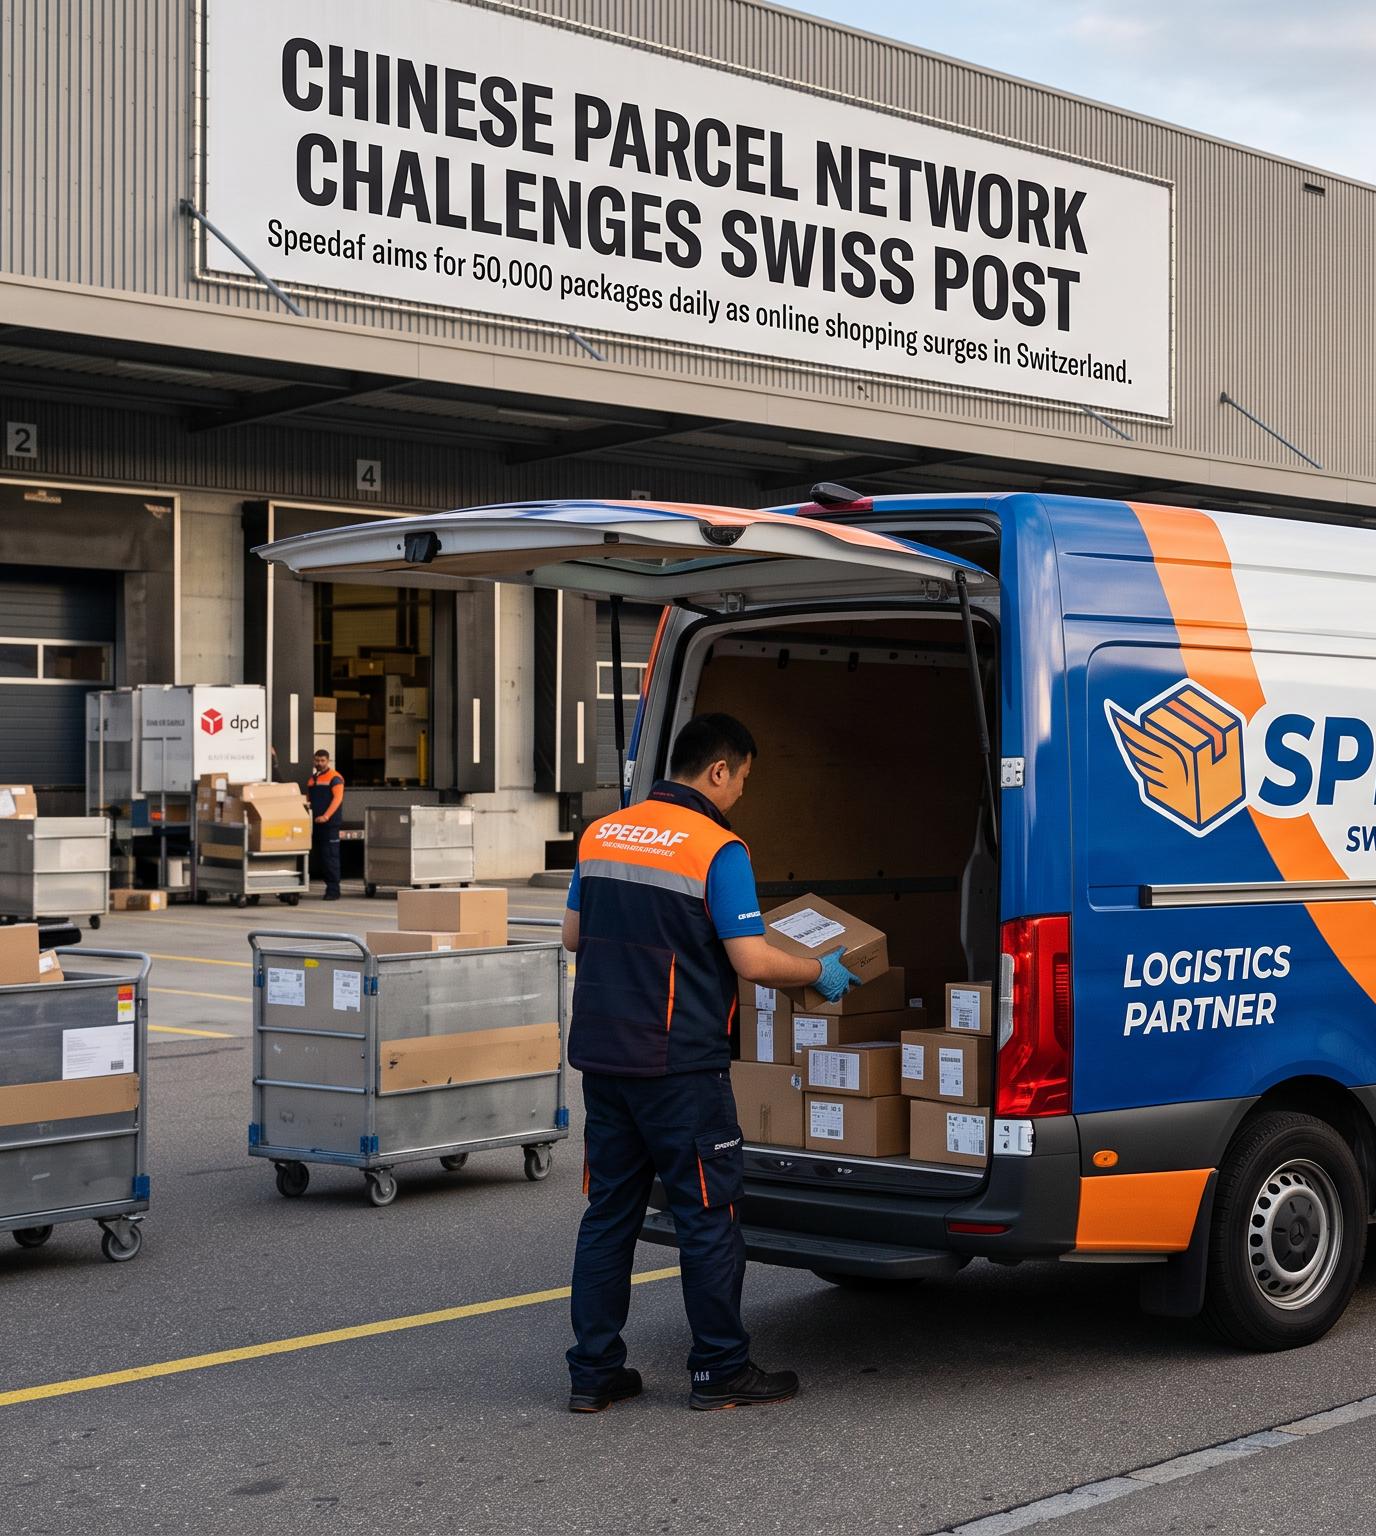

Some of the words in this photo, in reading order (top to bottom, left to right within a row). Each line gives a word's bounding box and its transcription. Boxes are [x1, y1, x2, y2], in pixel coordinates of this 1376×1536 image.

[281, 37, 554, 156] CHINESE
[574, 92, 799, 202] PARCEL
[816, 140, 1089, 255] NETWORK
[296, 132, 702, 269] CHALLENGES
[720, 209, 915, 305] SWISS
[934, 245, 1081, 332] POST
[267, 218, 366, 261] Speedaf
[372, 238, 428, 271] aims
[433, 246, 467, 277] for
[472, 253, 553, 292] 50,000
[560, 272, 663, 312] packages
[669, 286, 721, 324] daily
[726, 302, 750, 323] as
[756, 303, 819, 335] online
[825, 312, 918, 357] shopping
[923, 334, 988, 364] surges
[994, 338, 1011, 365] in
[1017, 342, 1132, 386] Switzerland.
[14, 427, 32, 453] 2
[360, 464, 377, 488] 4
[230, 714, 259, 733] dpd
[594, 822, 690, 848] SPEEDAF
[1123, 945, 1291, 988] LOGISTICS
[1123, 992, 1277, 1037] PARTNER
